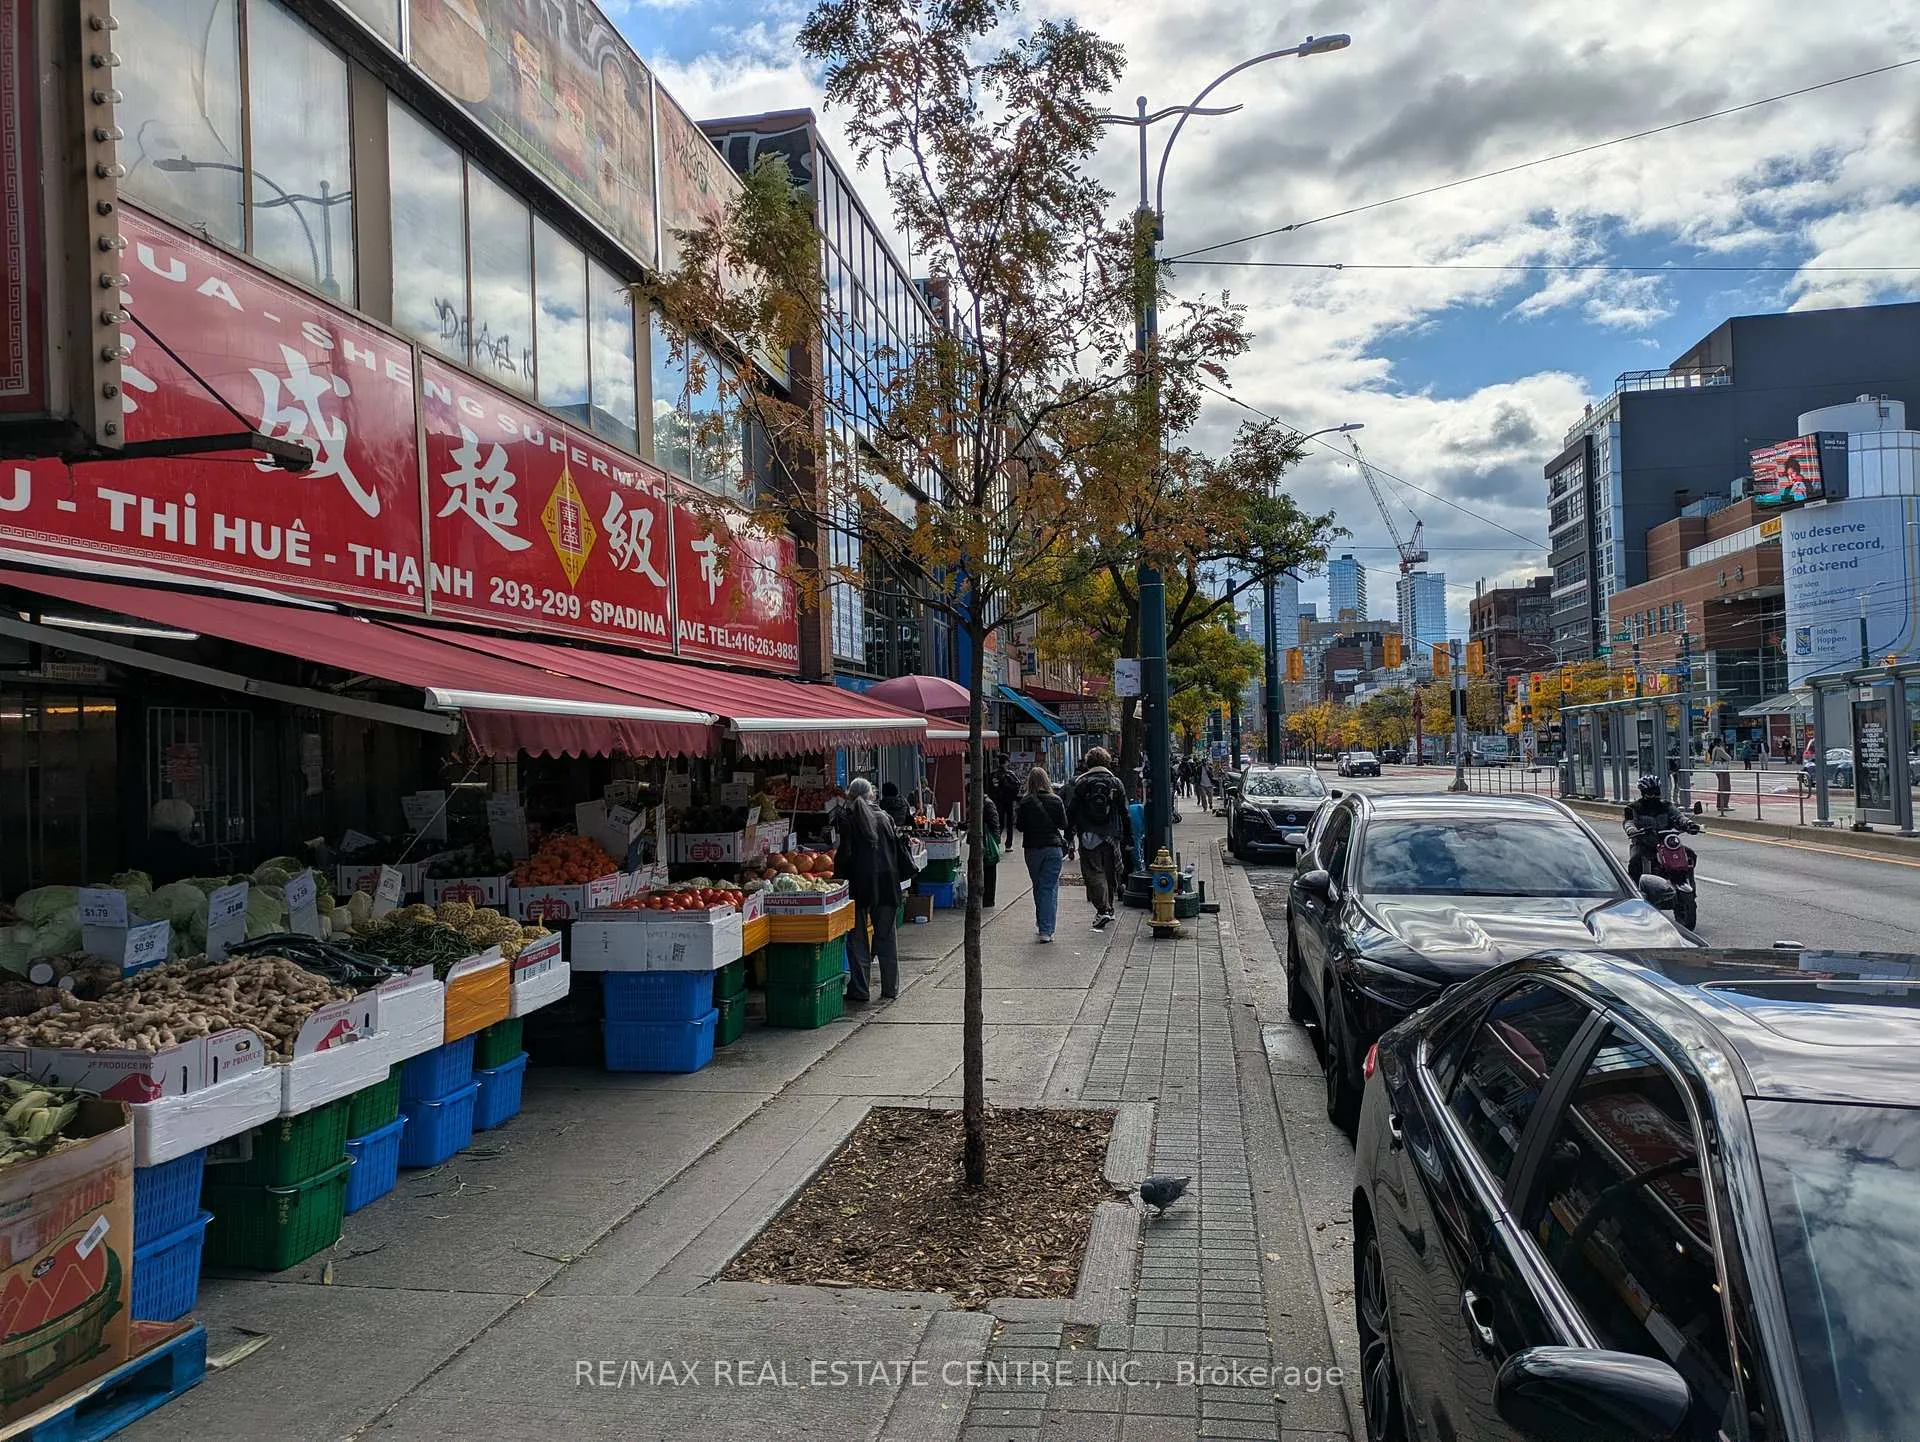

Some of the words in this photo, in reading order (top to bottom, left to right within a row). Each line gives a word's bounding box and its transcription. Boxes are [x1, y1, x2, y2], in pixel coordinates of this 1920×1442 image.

[119, 242, 244, 312] UA
[497, 413, 665, 503] SUPERMAR
[1790, 530, 1806, 541] You
[1808, 523, 1865, 538] deserve
[1797, 542, 1829, 557] track
[1832, 537, 1884, 552] record,
[213, 519, 311, 567] HUÊ
[489, 577, 580, 620] 293-299
[591, 602, 665, 637] SPADINA
[1792, 563, 1807, 575] not
[1809, 564, 1816, 573] a
[84, 907, 108, 918] $1.79
[233, 1049, 262, 1067] PRODUCE
